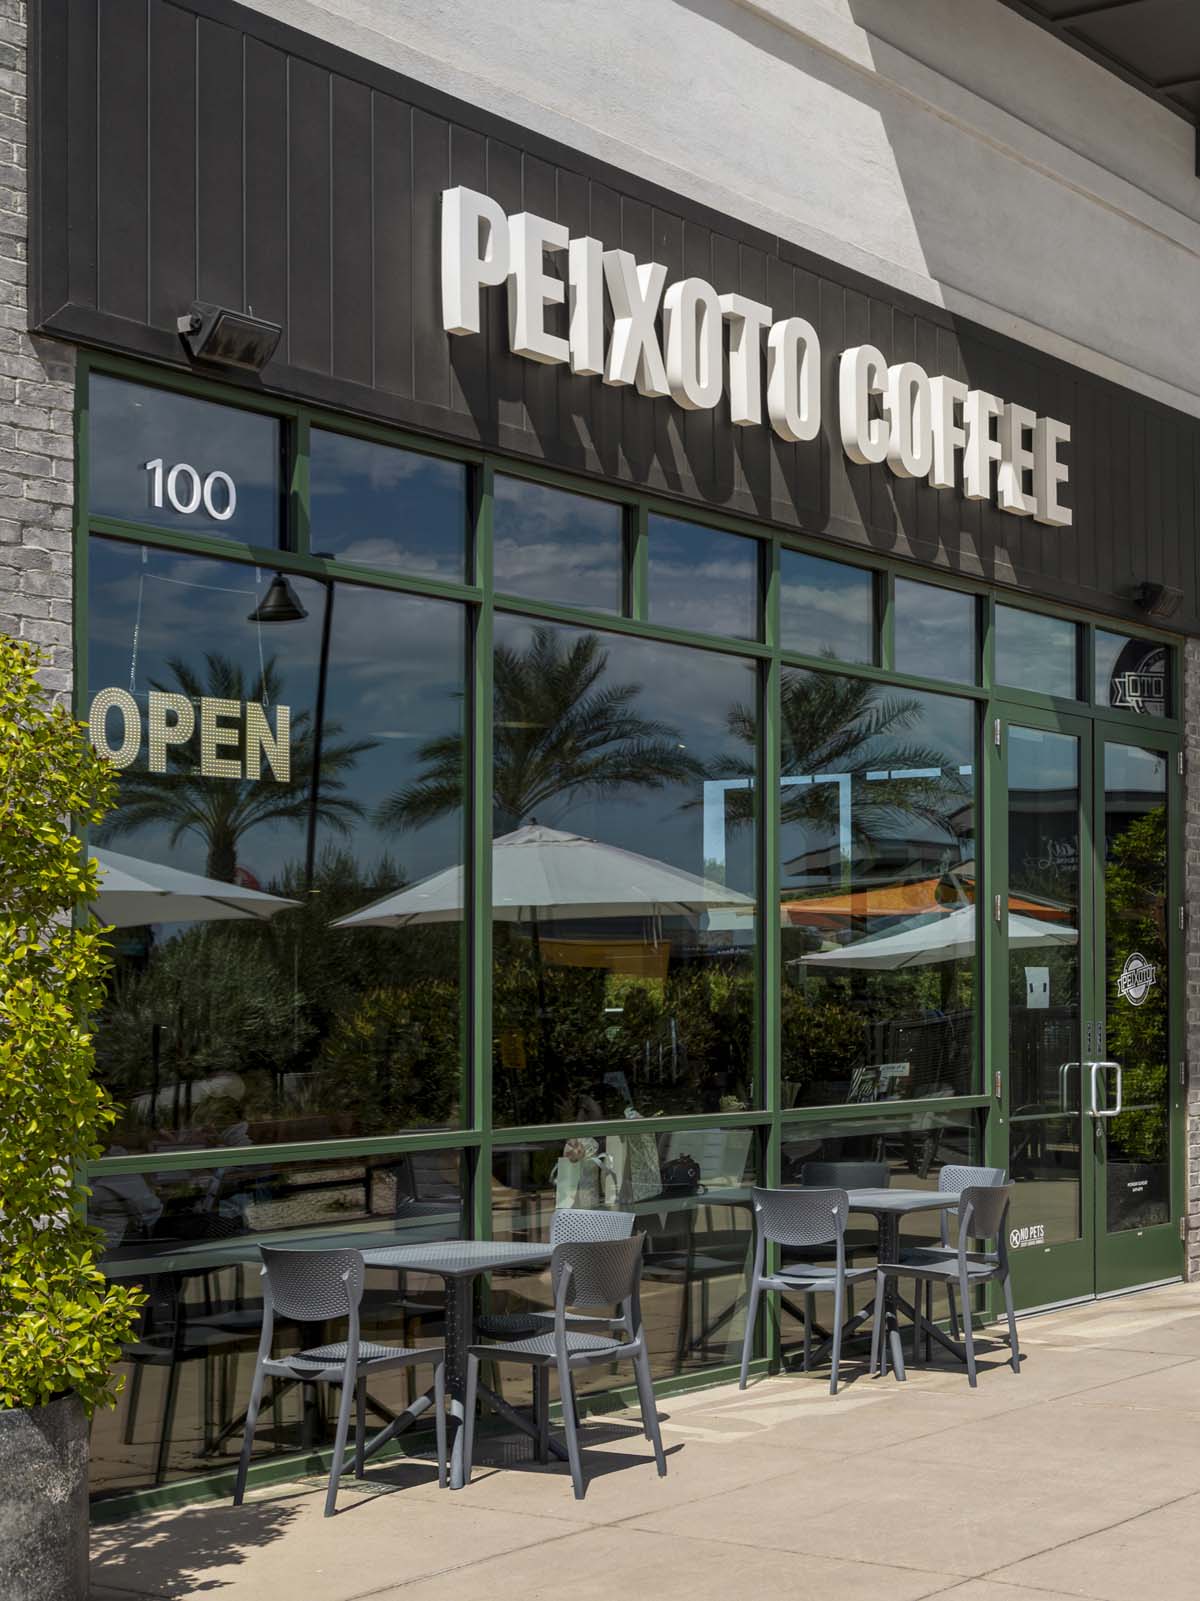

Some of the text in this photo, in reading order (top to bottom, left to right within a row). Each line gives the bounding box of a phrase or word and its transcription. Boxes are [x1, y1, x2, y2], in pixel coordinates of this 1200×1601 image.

[442, 185, 1072, 526] PEIXOTO COFFEE
[145, 458, 237, 521] 100
[89, 687, 290, 783] OPEN
[1020, 1224, 1045, 1240] NO PETS
